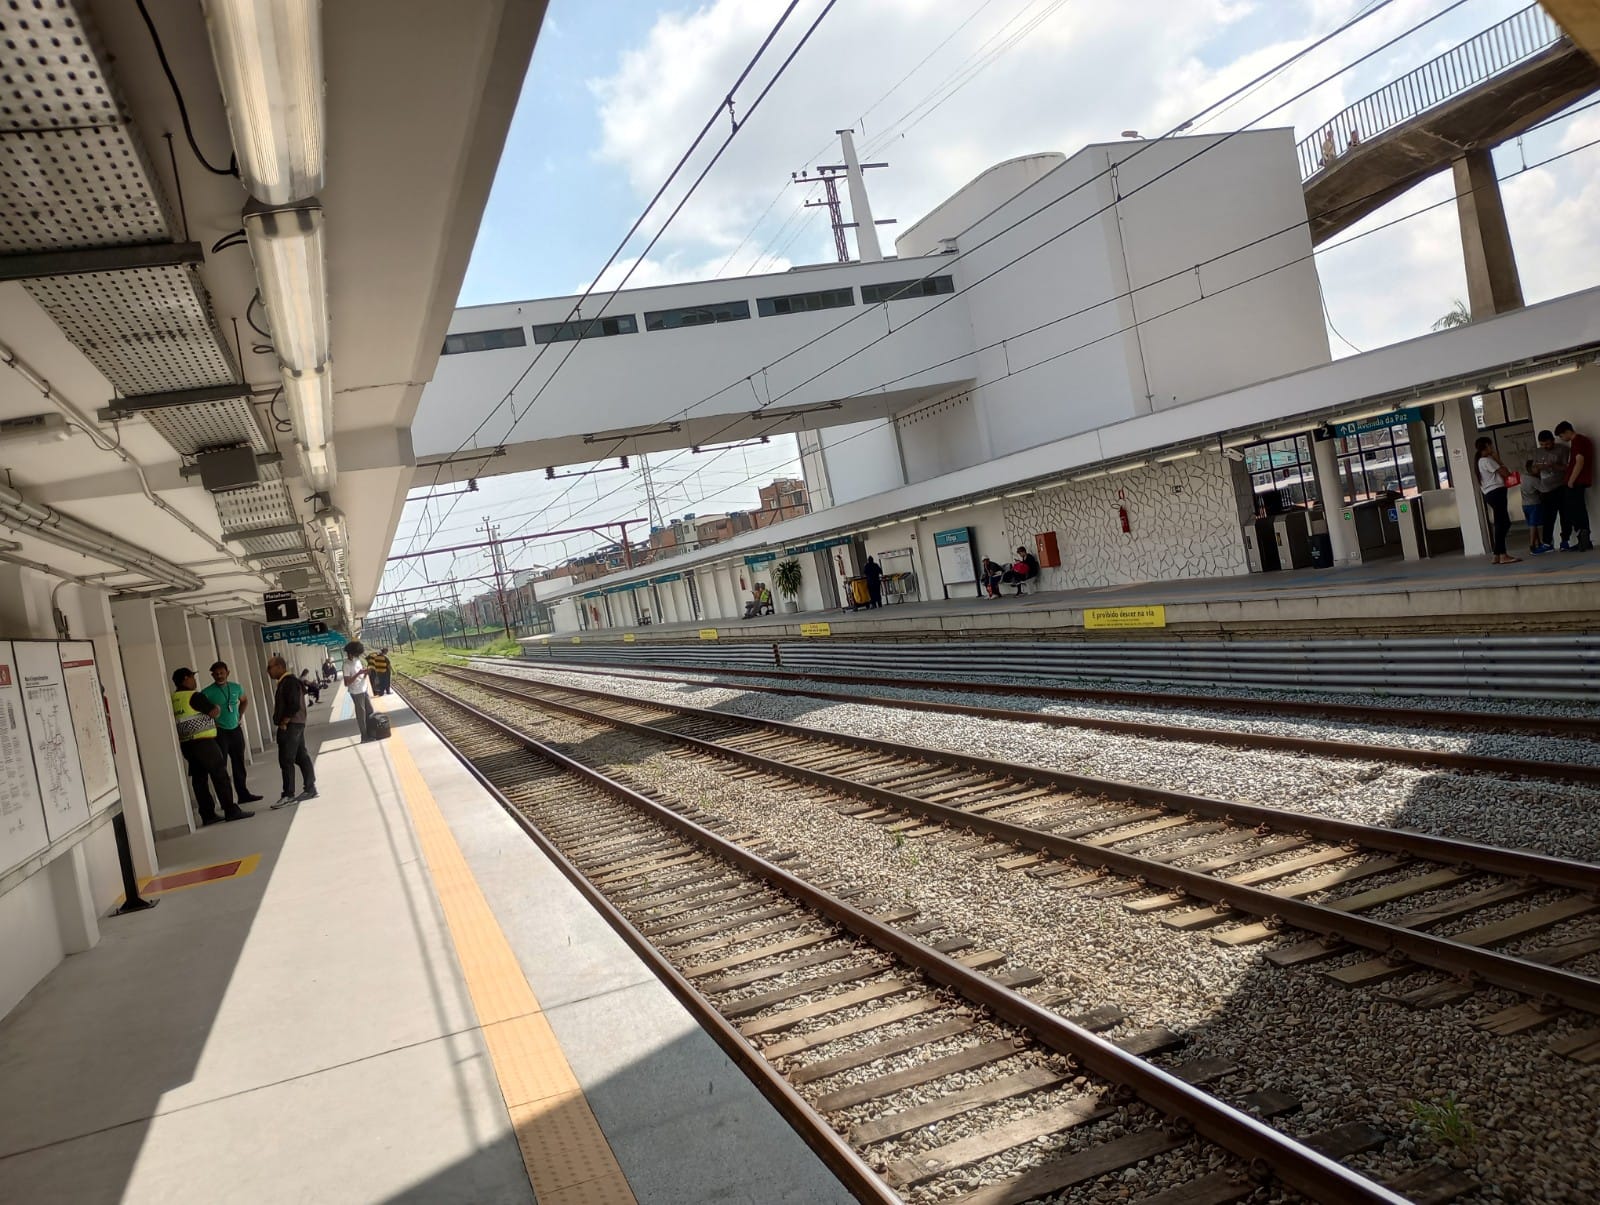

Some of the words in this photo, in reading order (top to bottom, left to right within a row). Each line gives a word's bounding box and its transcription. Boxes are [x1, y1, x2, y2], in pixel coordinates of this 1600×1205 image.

[1385, 415, 1394, 424] da
[1394, 414, 1408, 422] Paz
[1321, 428, 1329, 438] 2
[278, 604, 287, 617] 1
[1096, 611, 1118, 620] proibido
[1146, 609, 1154, 617] via
